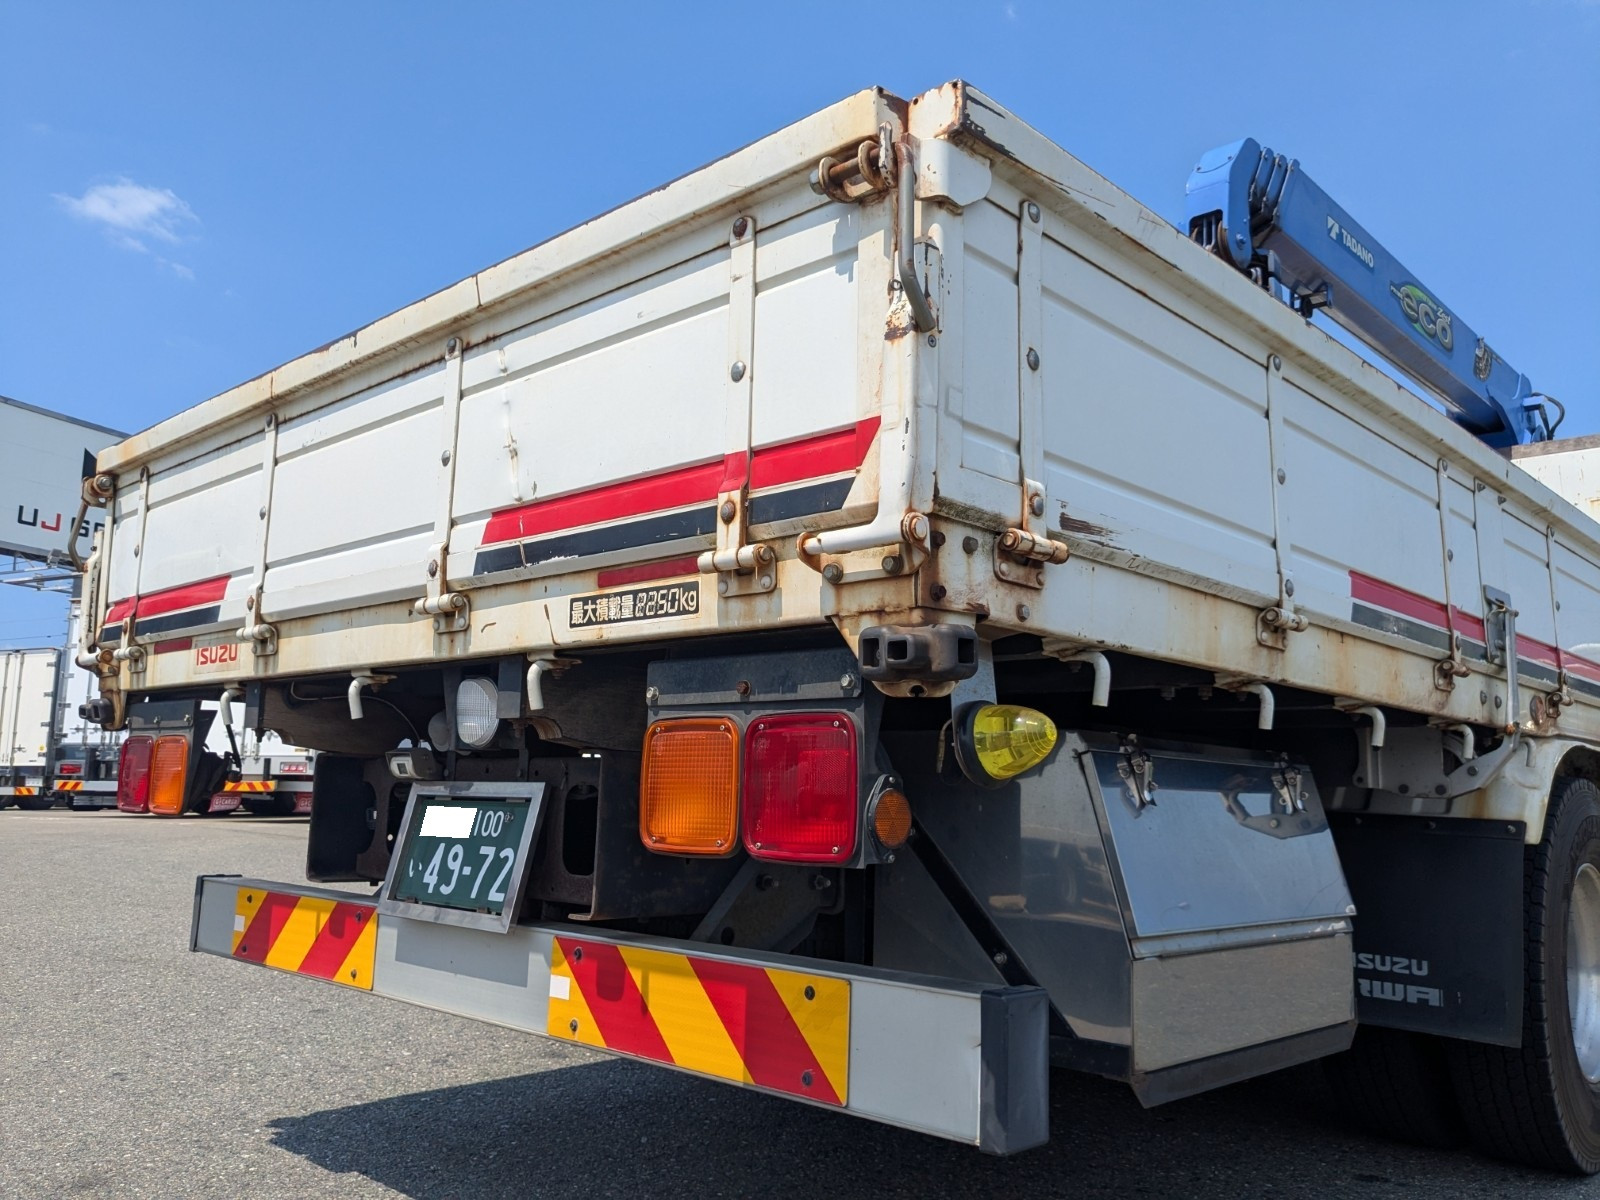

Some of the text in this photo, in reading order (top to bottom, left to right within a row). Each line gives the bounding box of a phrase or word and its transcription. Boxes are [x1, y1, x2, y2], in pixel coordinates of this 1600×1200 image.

[1341, 228, 1374, 268] TADANO
[196, 644, 238, 666] ISUZU
[473, 810, 504, 838] 100
